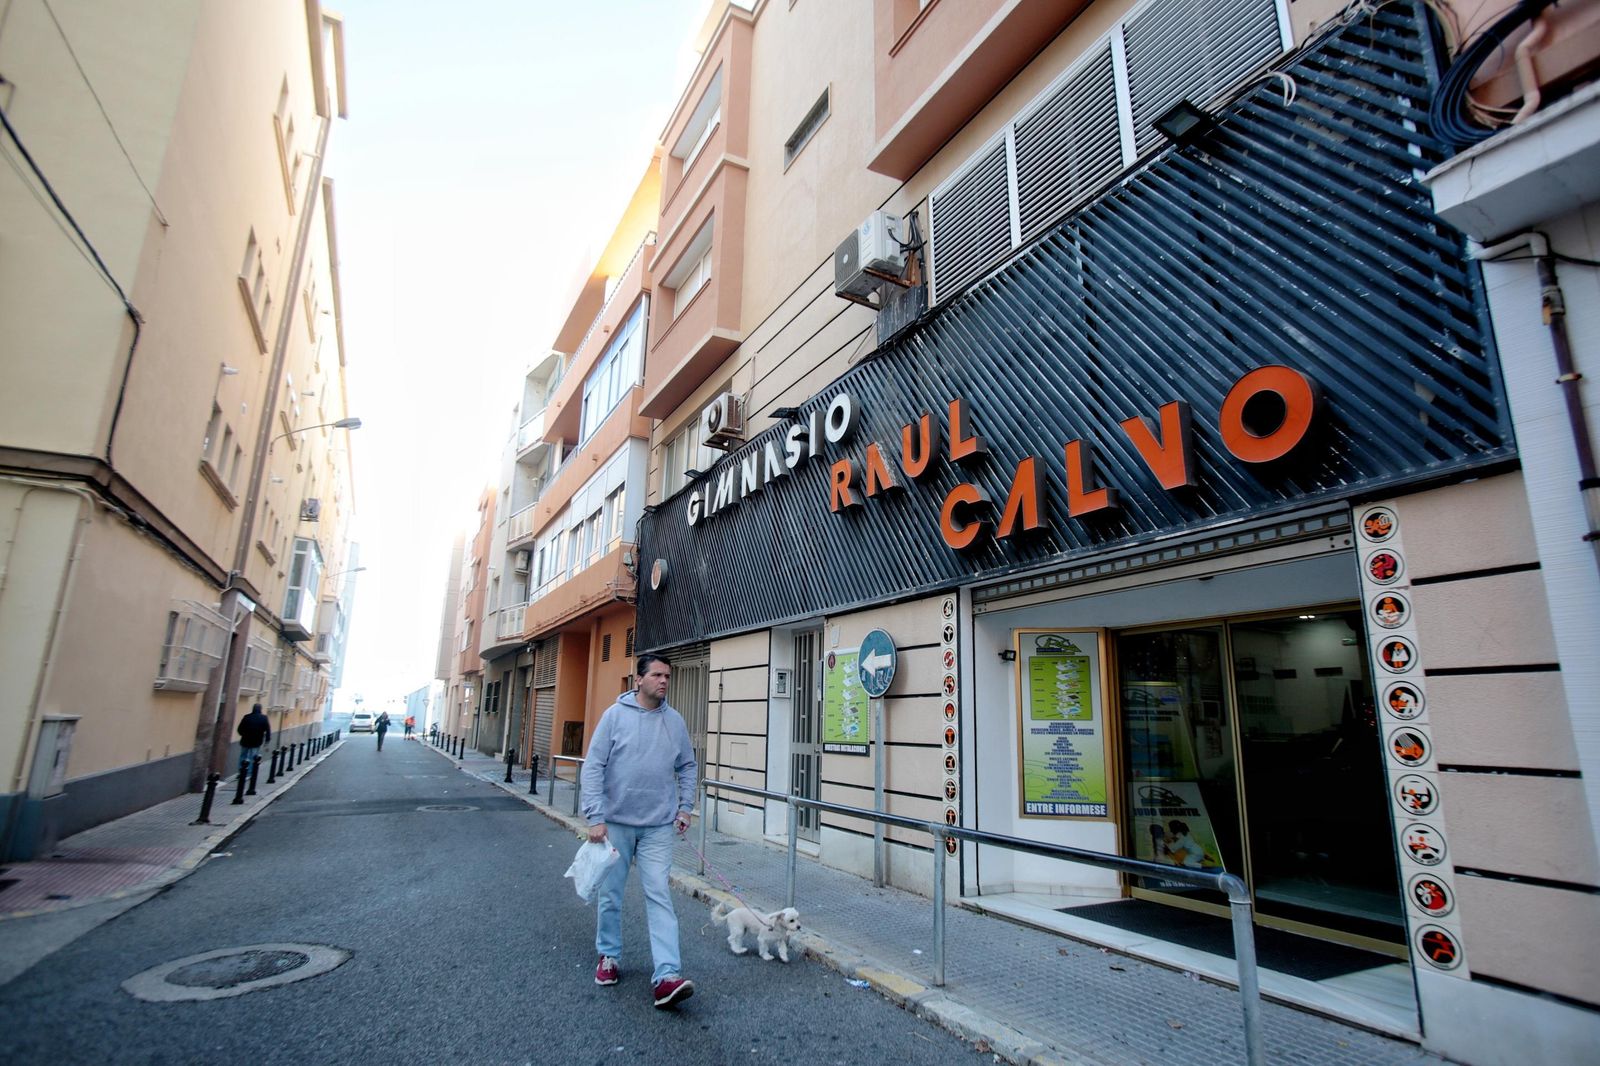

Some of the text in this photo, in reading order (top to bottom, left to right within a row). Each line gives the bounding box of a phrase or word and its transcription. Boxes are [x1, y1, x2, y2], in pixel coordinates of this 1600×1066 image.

[687, 393, 855, 527] GIMNASIO
[831, 398, 983, 515] RAUL
[939, 364, 1317, 551] CALVO
[1026, 803, 1106, 815] ENTRE INFORMESE
